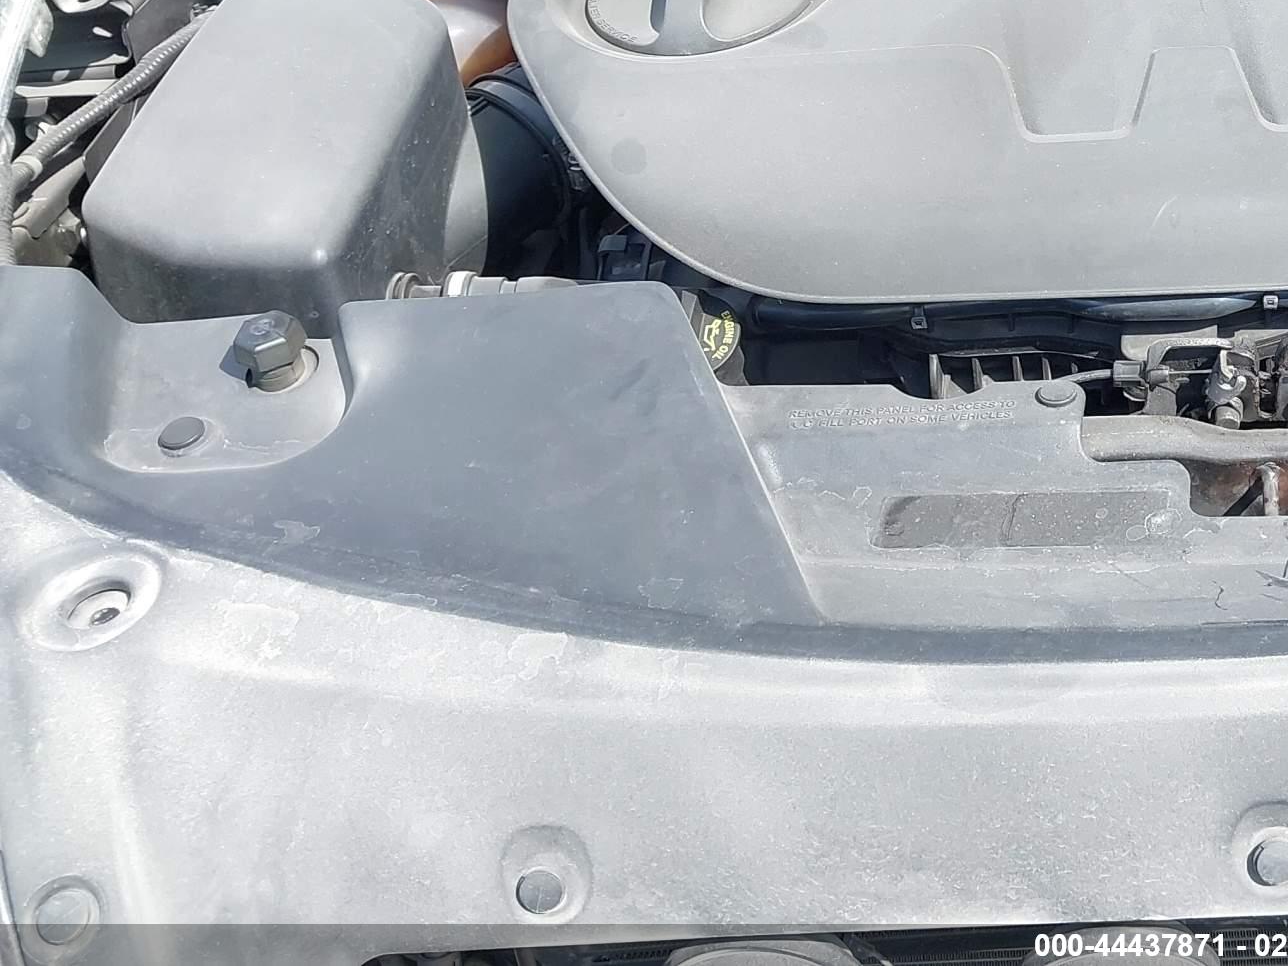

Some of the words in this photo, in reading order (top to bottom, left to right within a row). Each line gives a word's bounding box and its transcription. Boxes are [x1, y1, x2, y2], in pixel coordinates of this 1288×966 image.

[597, 19, 637, 43] SERVICE
[721, 310, 735, 344] ENGINE
[712, 345, 728, 360] OIL
[788, 409, 841, 419] REMOVE
[846, 407, 873, 417] THIS
[876, 405, 916, 416] PANEL
[919, 403, 944, 414] FOR
[949, 401, 996, 412] ACCESS
[999, 400, 1016, 409] TO
[818, 418, 845, 428] FILL
[886, 415, 906, 425] ON
[910, 413, 947, 424] SOME
[950, 410, 1013, 422] VEHICLES
